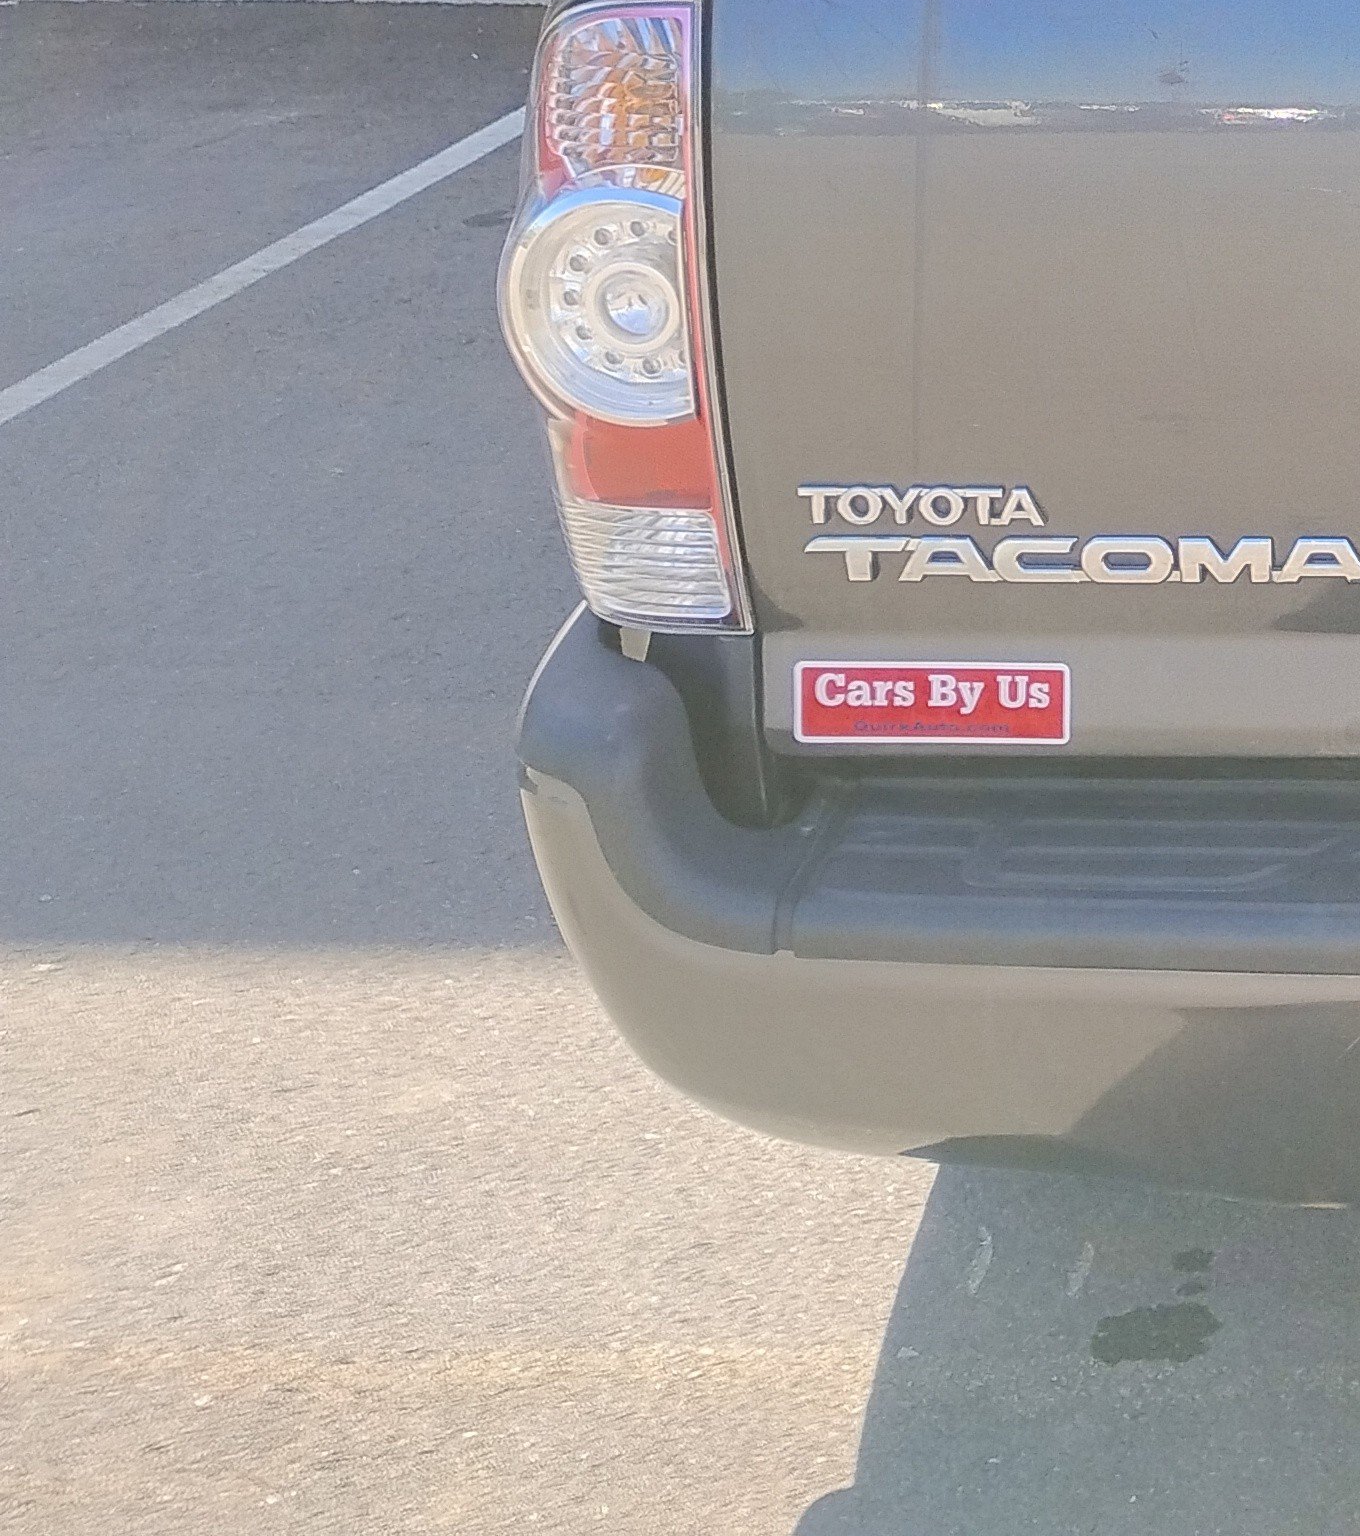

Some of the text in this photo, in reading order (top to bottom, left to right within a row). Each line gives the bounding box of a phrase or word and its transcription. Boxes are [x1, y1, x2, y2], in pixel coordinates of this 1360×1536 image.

[797, 485, 1046, 526] TOYOTA
[814, 673, 1051, 715] Cars By Us
